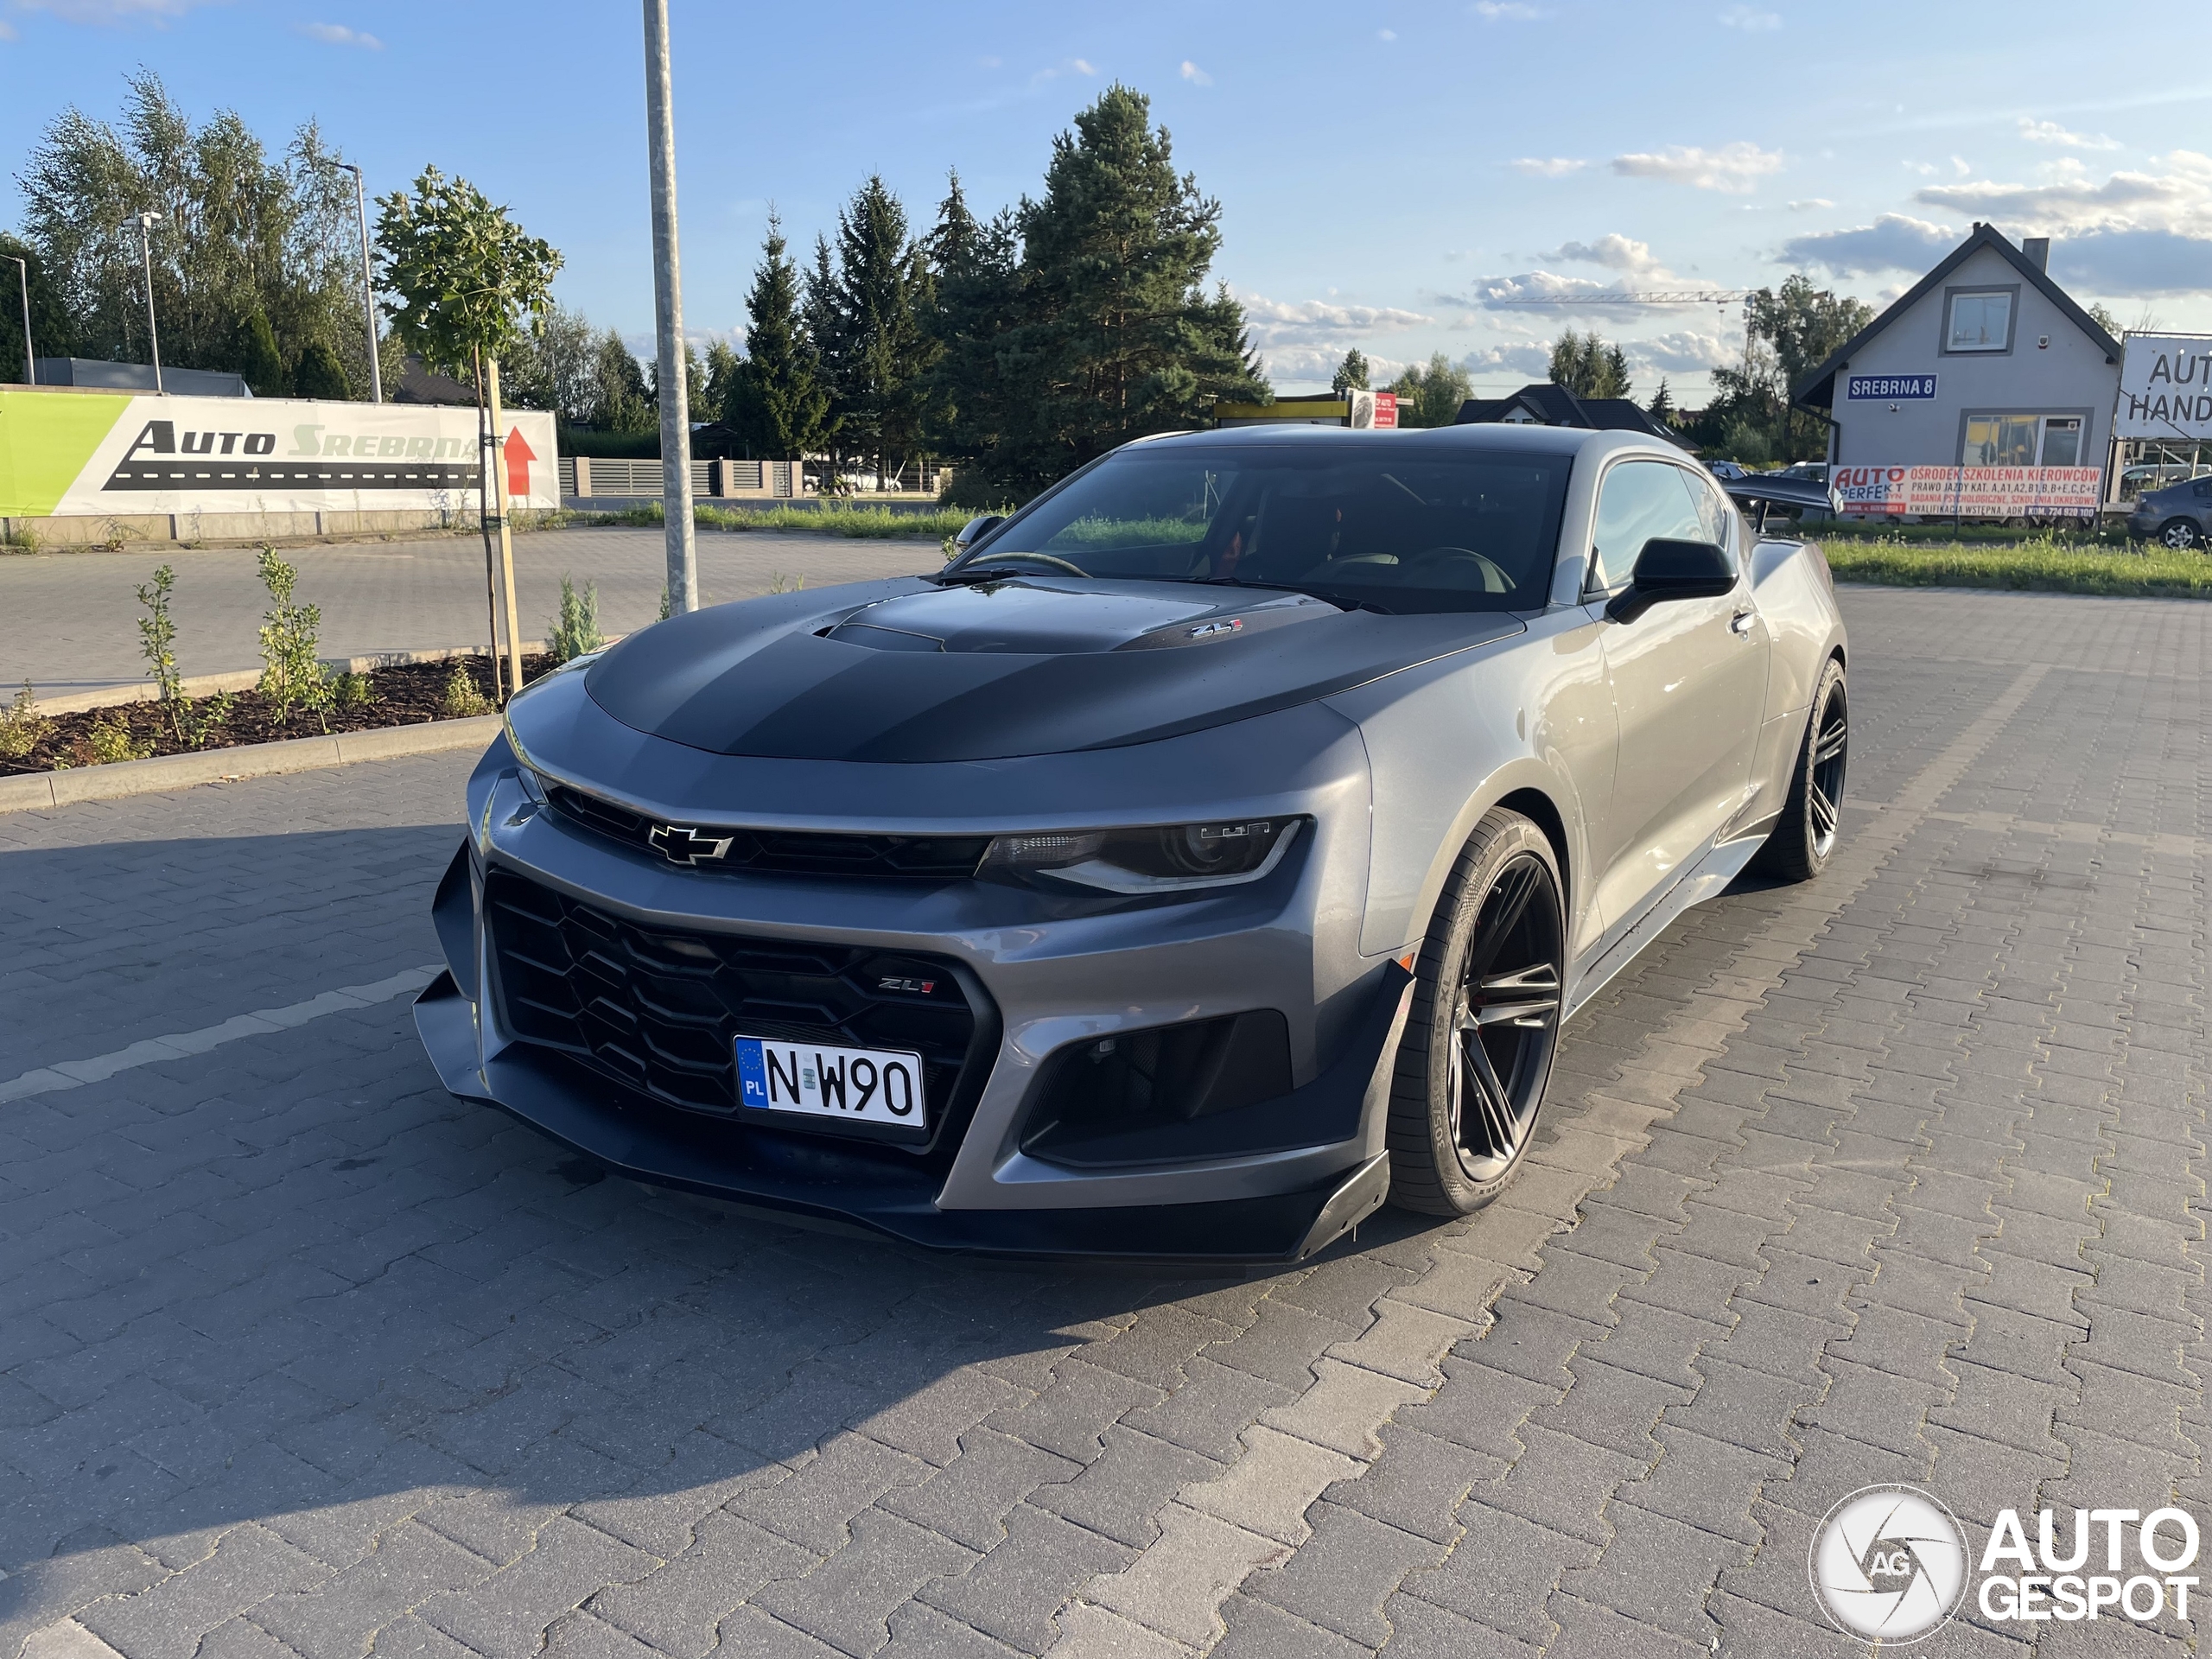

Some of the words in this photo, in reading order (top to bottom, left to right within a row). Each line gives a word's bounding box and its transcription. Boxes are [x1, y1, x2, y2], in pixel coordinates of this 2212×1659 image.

[1852, 379, 1920, 396] SREBRNA
[1923, 379, 1933, 394] 8
[2129, 394, 2212, 421] HAND
[129, 420, 276, 454] AUTO
[1835, 468, 1905, 490] AUTO
[1910, 467, 1960, 480] OŚRODEK
[1963, 468, 2024, 480] SZKOLENIA
[2027, 467, 2100, 481] KIEROWCÓW
[1840, 483, 1904, 499] PERFEKT
[1911, 482, 1942, 492] PRAWO
[1944, 482, 1967, 493] JAZDY
[1971, 483, 1988, 493] KAT.
[1910, 493, 1942, 502] BADANIA
[2012, 495, 2051, 504] SZKOLENIA
[2054, 496, 2096, 505] OKRESOWE
[1910, 505, 1962, 514] KWALIFIKACJA
[2006, 506, 2022, 515] ADR
[1191, 619, 1243, 639] ZL1
[878, 977, 936, 994] ZL1
[1439, 975, 1452, 1005] XL
[746, 1081, 764, 1096] PL
